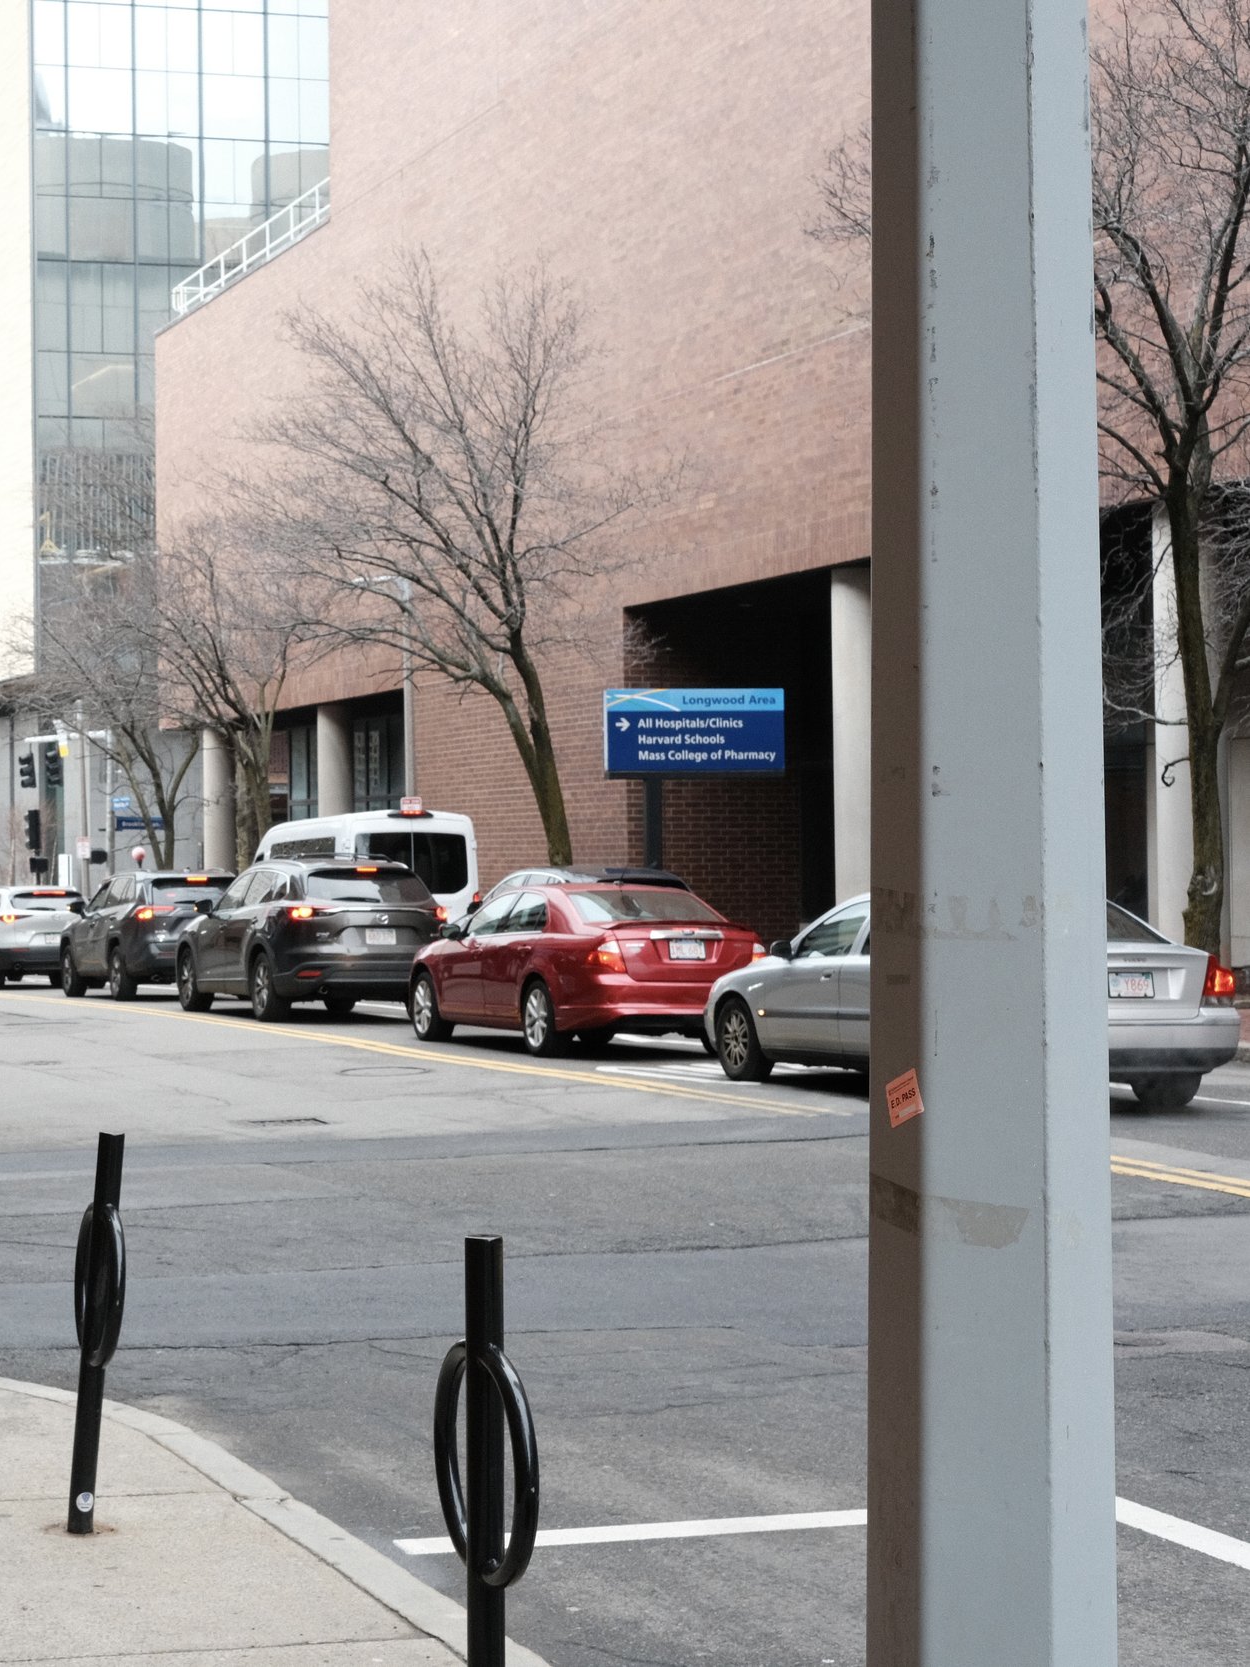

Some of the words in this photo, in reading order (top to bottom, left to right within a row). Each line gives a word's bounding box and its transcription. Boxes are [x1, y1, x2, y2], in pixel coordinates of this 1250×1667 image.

[682, 695, 745, 707] Longwood
[748, 696, 776, 705] Area
[637, 718, 653, 728] All
[655, 717, 743, 730] Hospitals/Clinics
[638, 734, 682, 744] Harvard
[684, 734, 725, 744] Schools
[638, 750, 666, 760] Mass
[668, 750, 708, 762] College
[710, 750, 722, 760] of
[724, 750, 776, 762] Pharmacy
[902, 1088, 916, 1102] PASS
